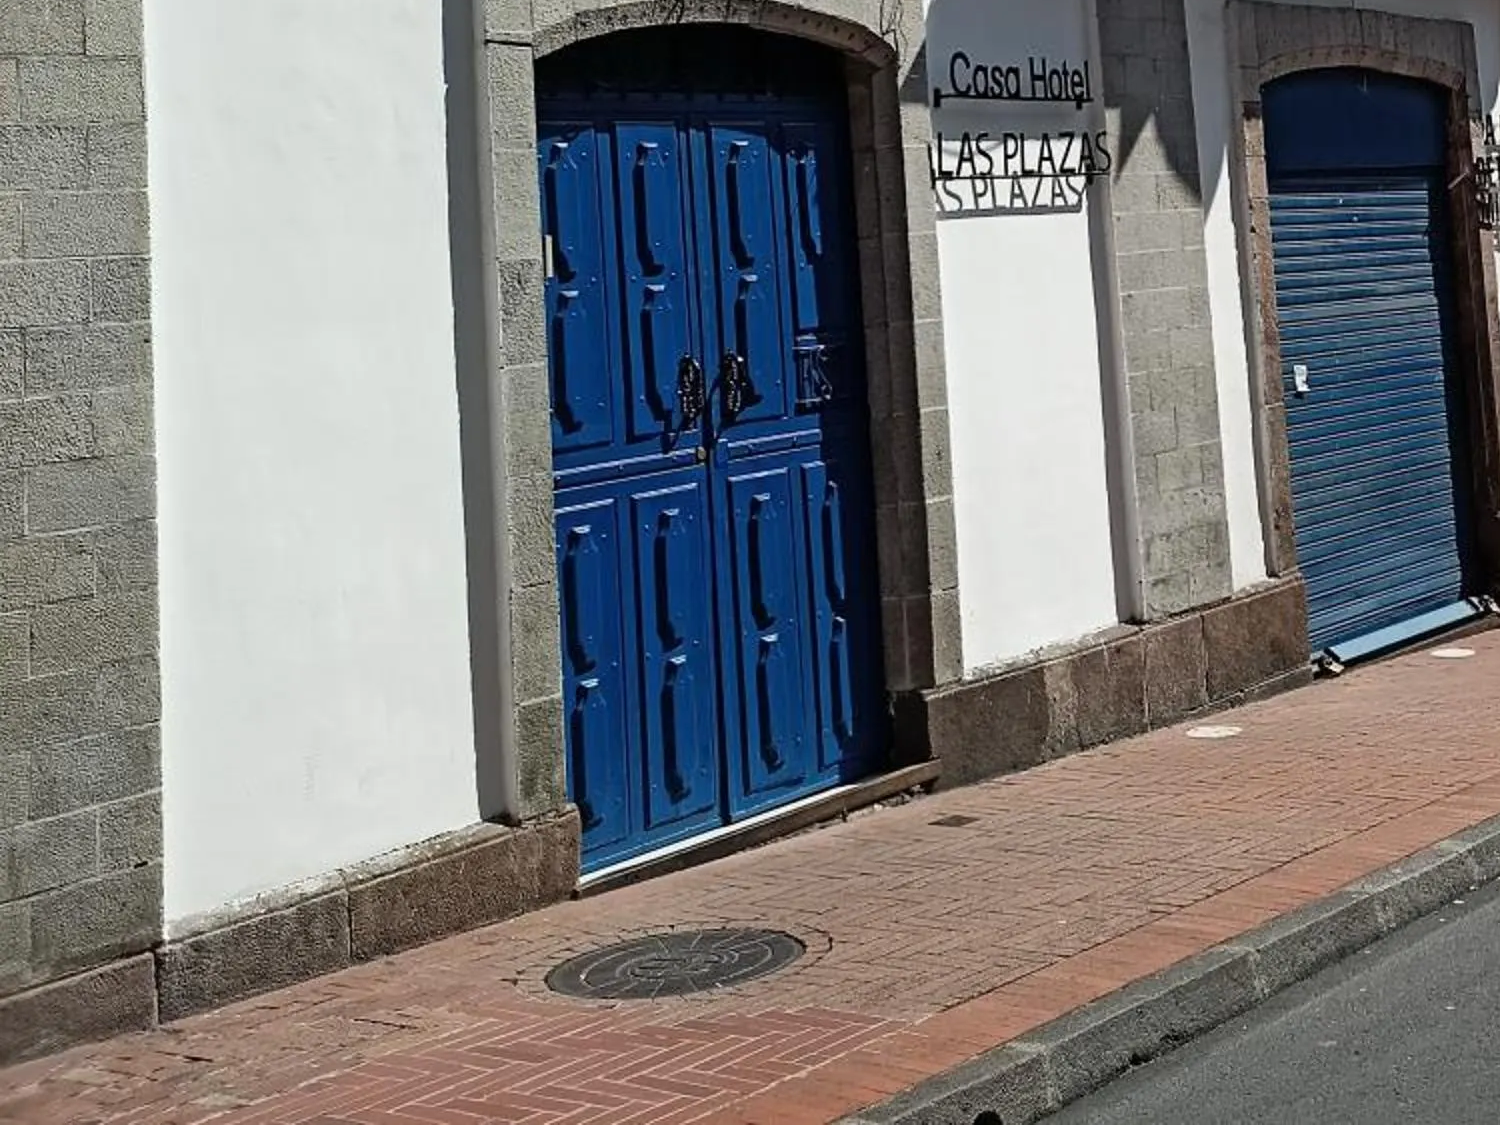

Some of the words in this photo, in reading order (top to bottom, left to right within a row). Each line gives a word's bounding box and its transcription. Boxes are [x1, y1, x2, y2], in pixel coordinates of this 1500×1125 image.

[949, 51, 1021, 99] Casa
[1029, 56, 1091, 100] Hotel
[937, 132, 994, 177] LAS
[1003, 130, 1112, 176] PLAZAS
